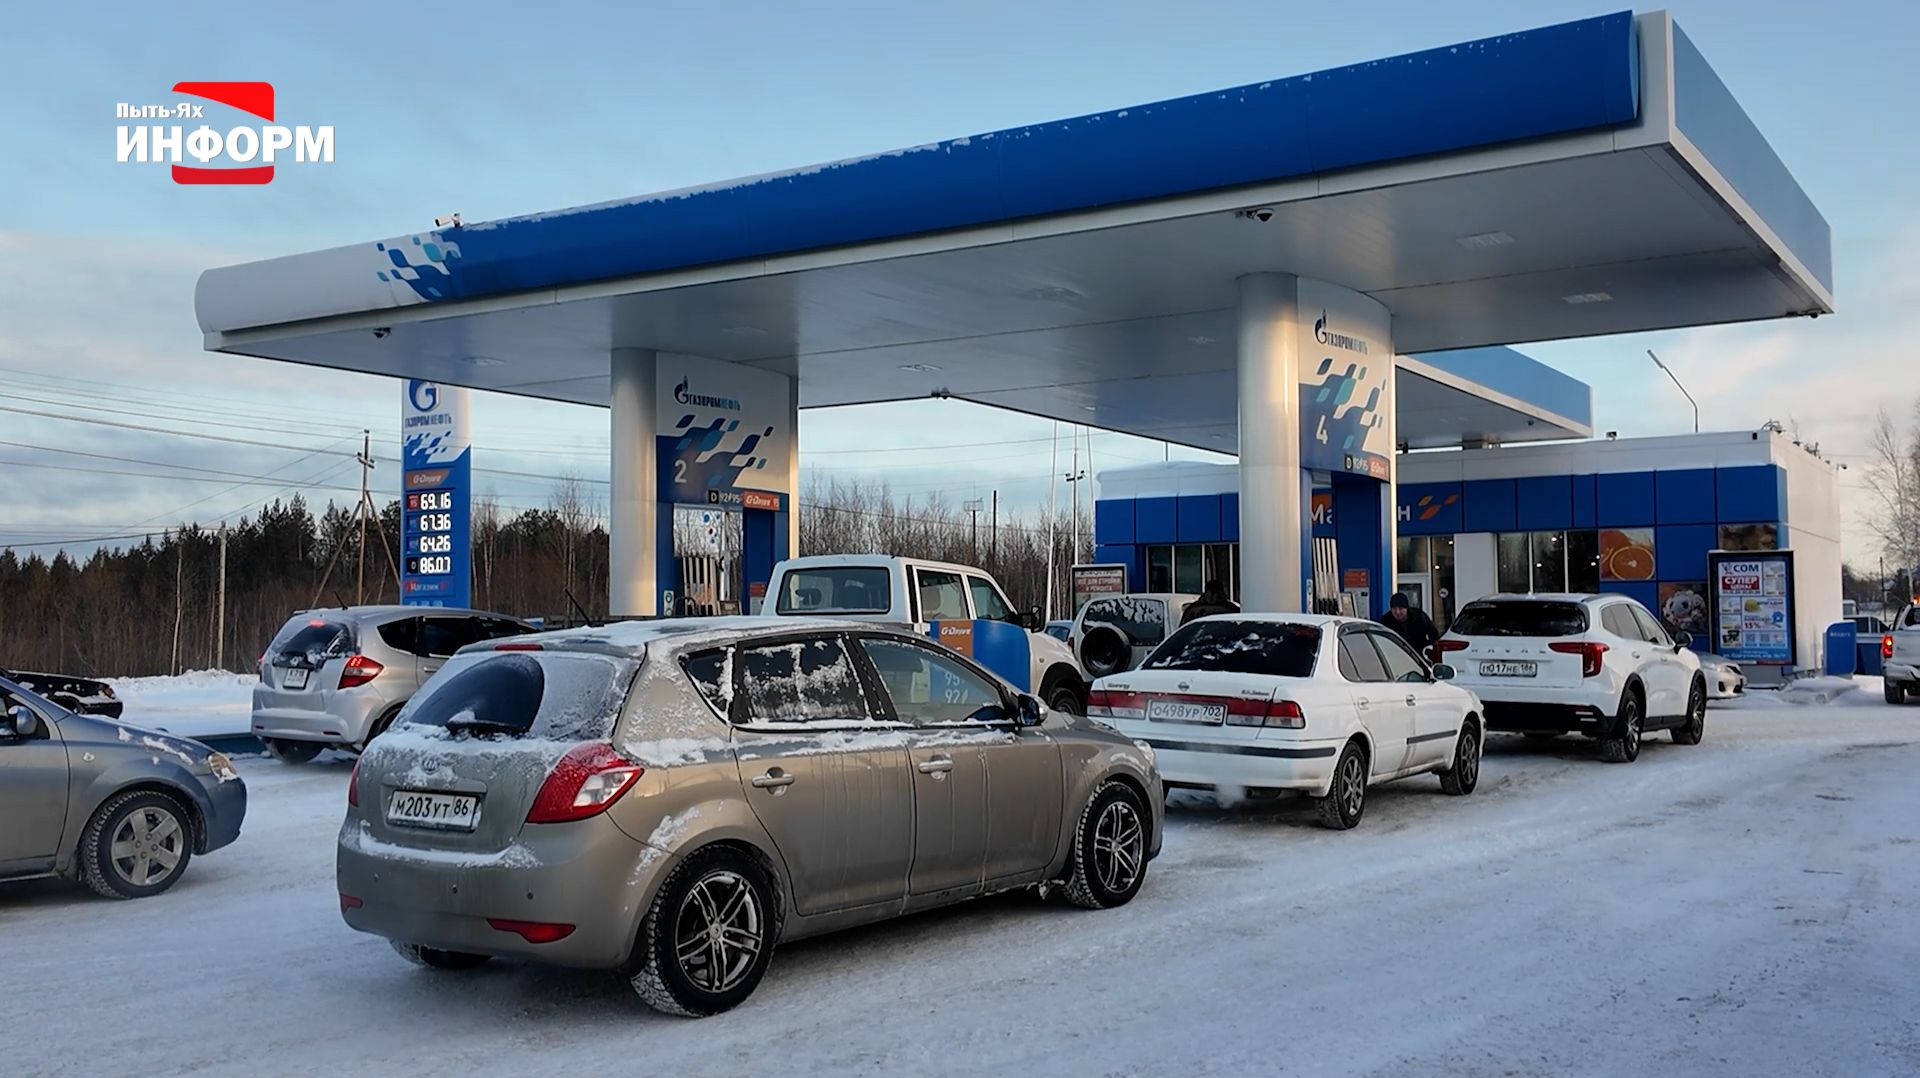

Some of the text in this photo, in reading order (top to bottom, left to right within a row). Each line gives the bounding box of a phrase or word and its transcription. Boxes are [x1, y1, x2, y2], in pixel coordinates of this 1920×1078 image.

[1316, 415, 1328, 444] 4
[674, 459, 687, 483] 2
[420, 492, 452, 510] 69.16
[710, 491, 717, 502] D
[420, 513, 451, 531] 67.36
[420, 534, 451, 552] 64.26
[420, 556, 450, 574] 86.07
[1202, 705, 1222, 717] 702
[395, 796, 469, 819] М203УТ 86
